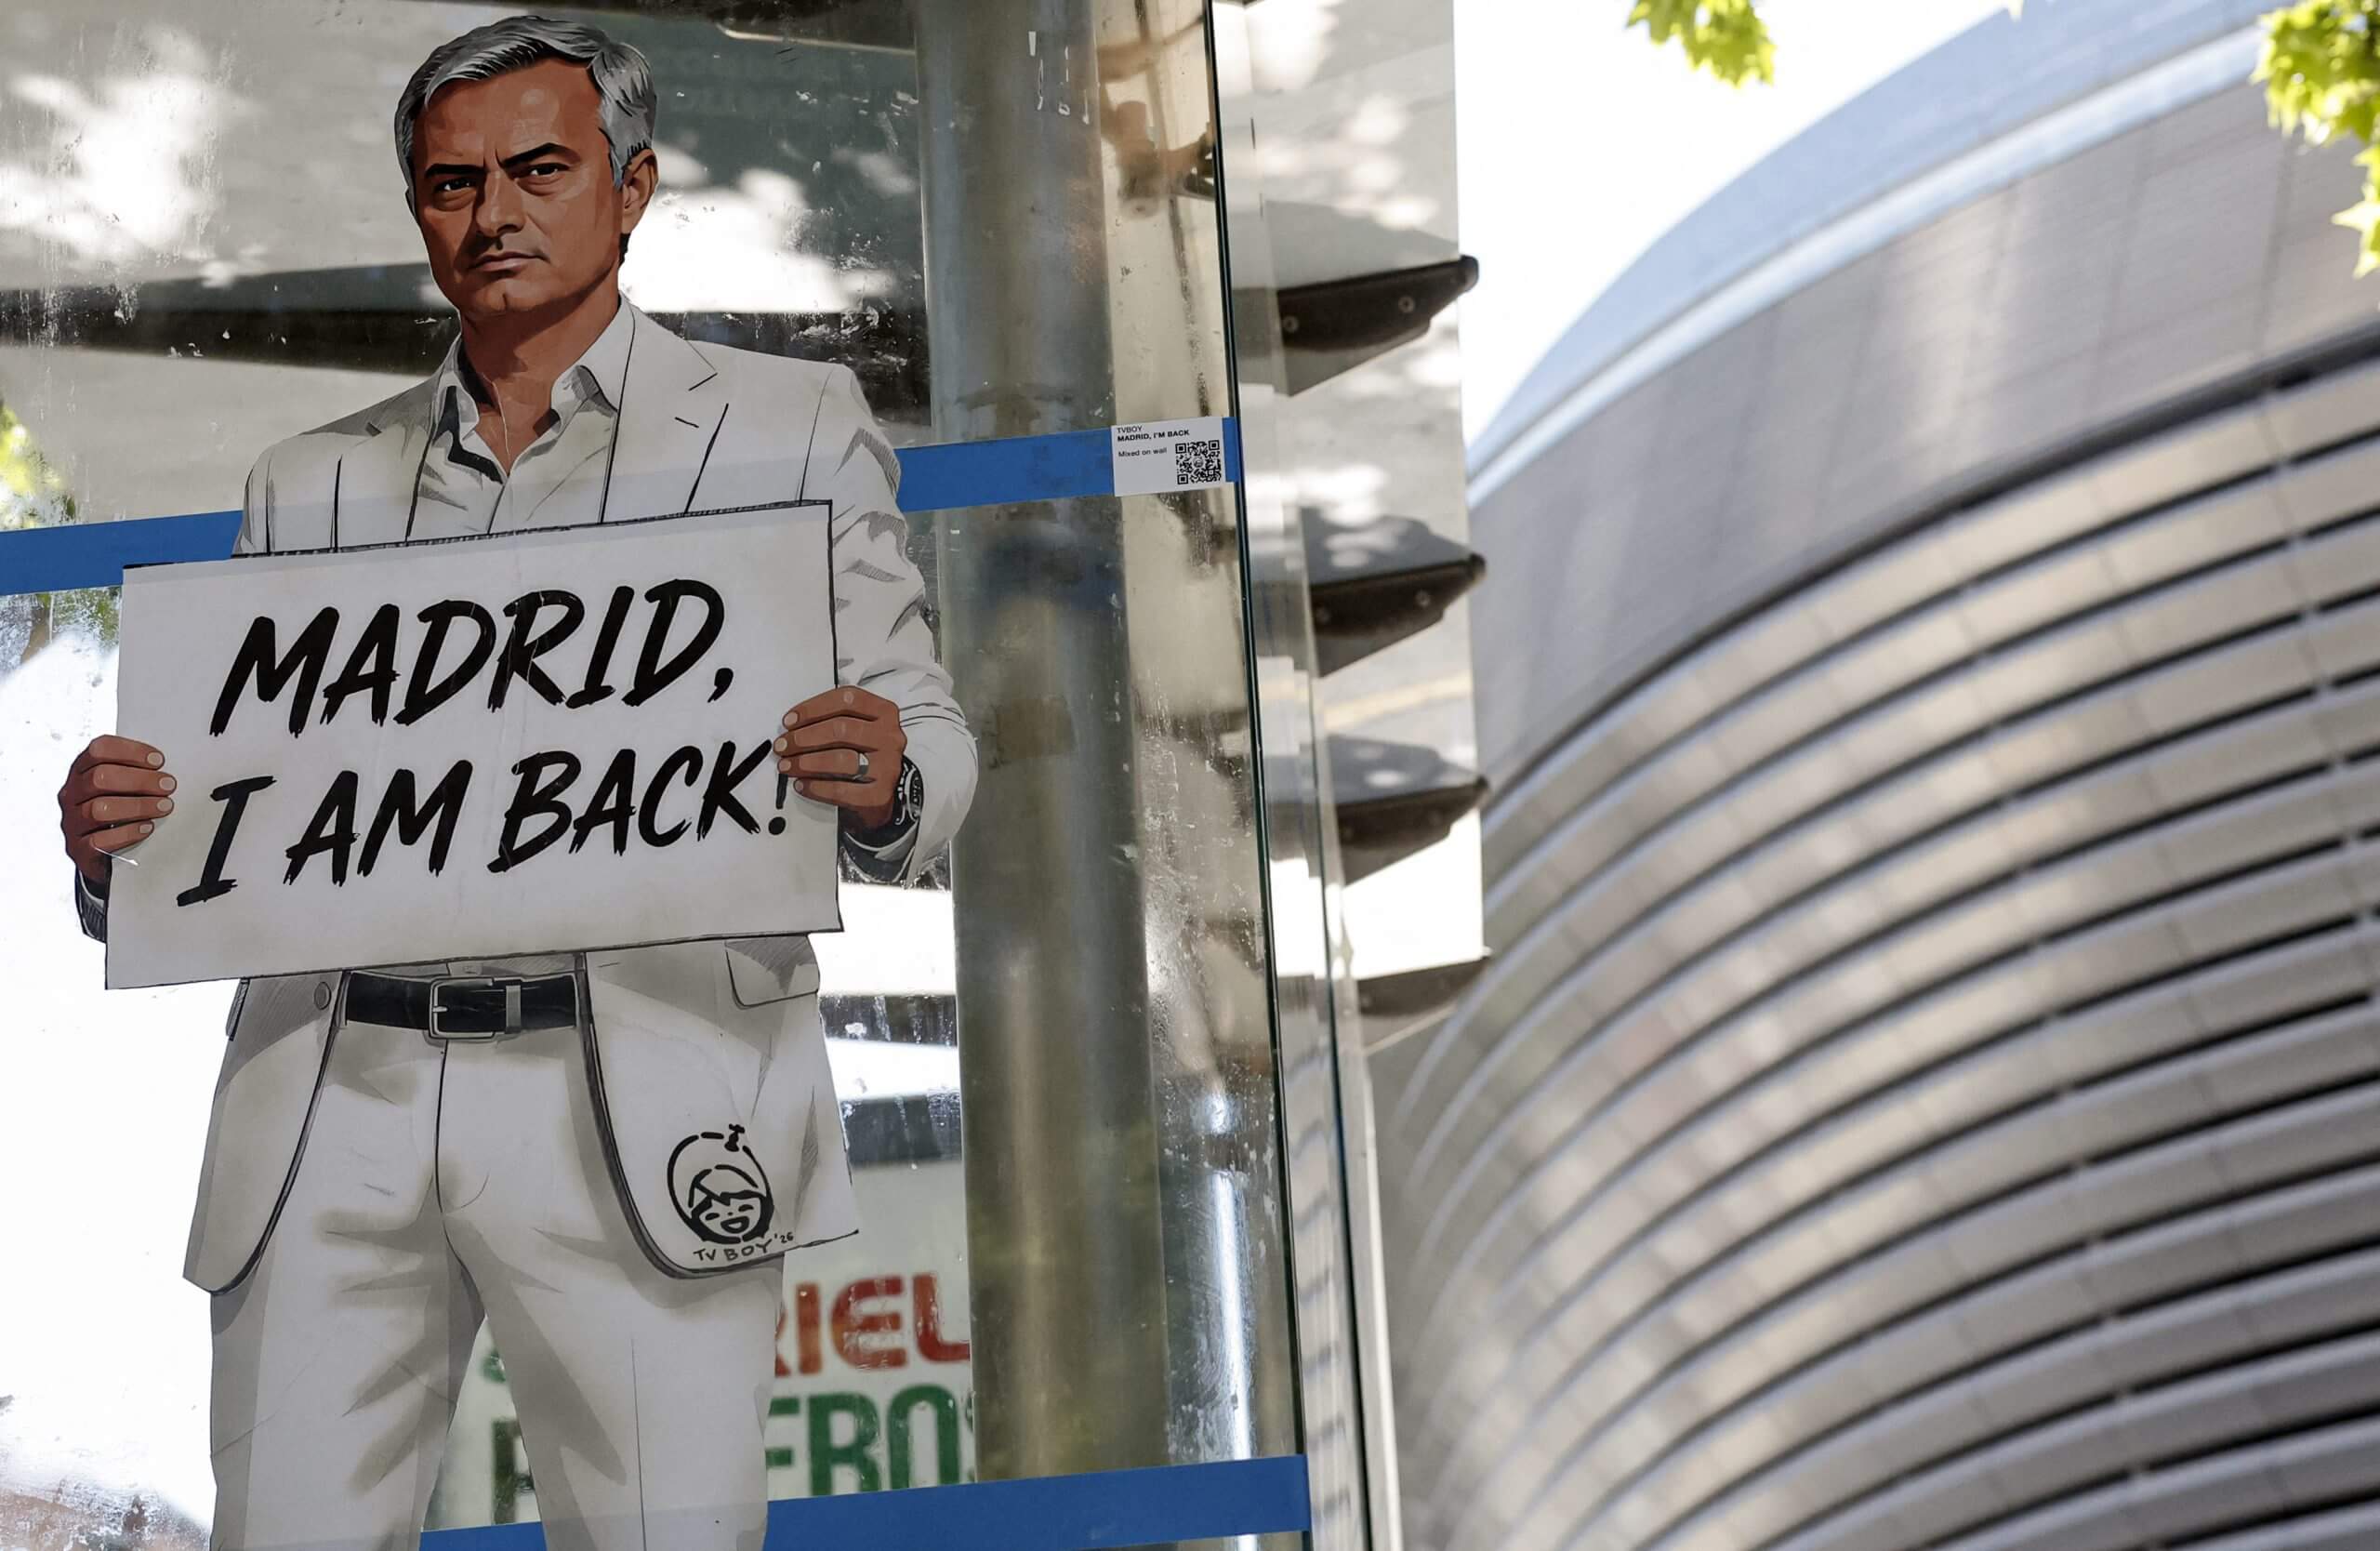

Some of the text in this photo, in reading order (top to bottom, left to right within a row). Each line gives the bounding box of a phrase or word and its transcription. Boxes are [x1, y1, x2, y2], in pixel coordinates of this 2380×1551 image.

[1117, 425, 1143, 433] TVBOY
[1117, 432, 1152, 442] MADRID,
[1167, 430, 1190, 438] BACK
[1118, 449, 1140, 457] Mixed
[209, 578, 734, 737] MADRID,
[177, 737, 787, 907] I AM BACK!
[693, 1249, 716, 1261] TV
[723, 1239, 773, 1261] BOY
